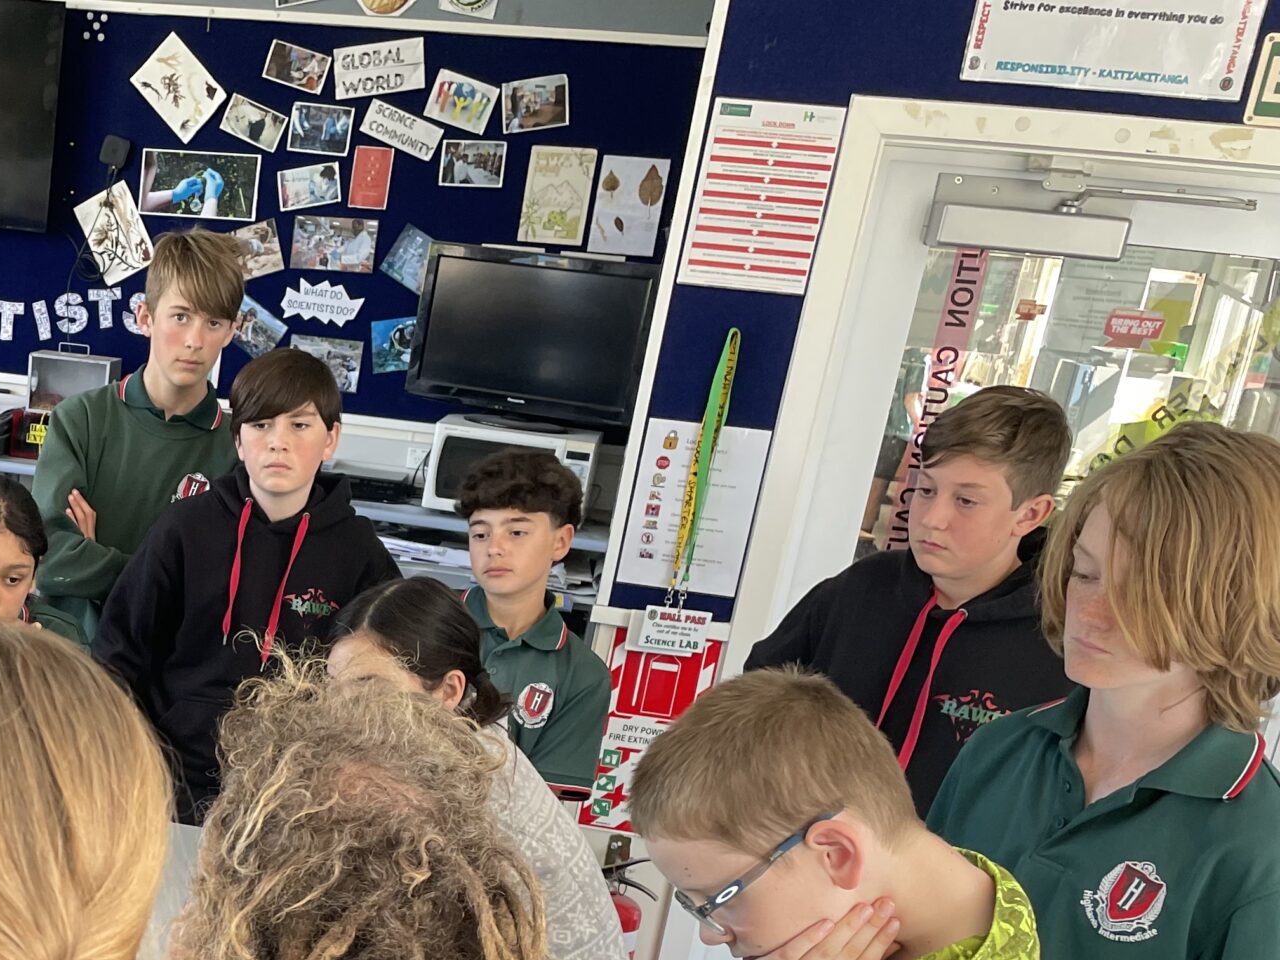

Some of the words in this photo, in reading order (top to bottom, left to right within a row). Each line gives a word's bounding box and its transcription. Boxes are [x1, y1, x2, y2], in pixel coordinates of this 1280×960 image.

[1003, 0, 1036, 12] Strive
[1037, 2, 1057, 12] for
[1114, 8, 1125, 17] in
[1127, 10, 1186, 23] everything
[1187, 14, 1207, 24] you
[1210, 14, 1224, 25] do
[973, 1, 992, 49] RESPECT
[341, 47, 405, 71] GLOBAL
[995, 60, 1091, 78] RESPONSIBILITY
[342, 73, 405, 96] WORLD
[375, 104, 417, 130] SCIENCE
[368, 120, 434, 157] COMMUNITY
[304, 287, 329, 299] WHAT
[330, 290, 343, 301] DO
[287, 299, 335, 314] SCIENTISTS
[336, 306, 356, 316] DO?
[1110, 318, 1140, 327] BRING
[1142, 320, 1162, 329] OUT
[1111, 325, 1130, 334] THE
[1130, 327, 1155, 336] BEST
[660, 611, 682, 622] HALL
[684, 614, 707, 625] PASS
[643, 635, 677, 648] SCIENCE
[679, 639, 699, 650] LAB
[608, 732, 627, 742] FIRE
[622, 724, 639, 733] DRY
[640, 726, 665, 736] POWD
[1098, 928, 1158, 943] Intermediate
